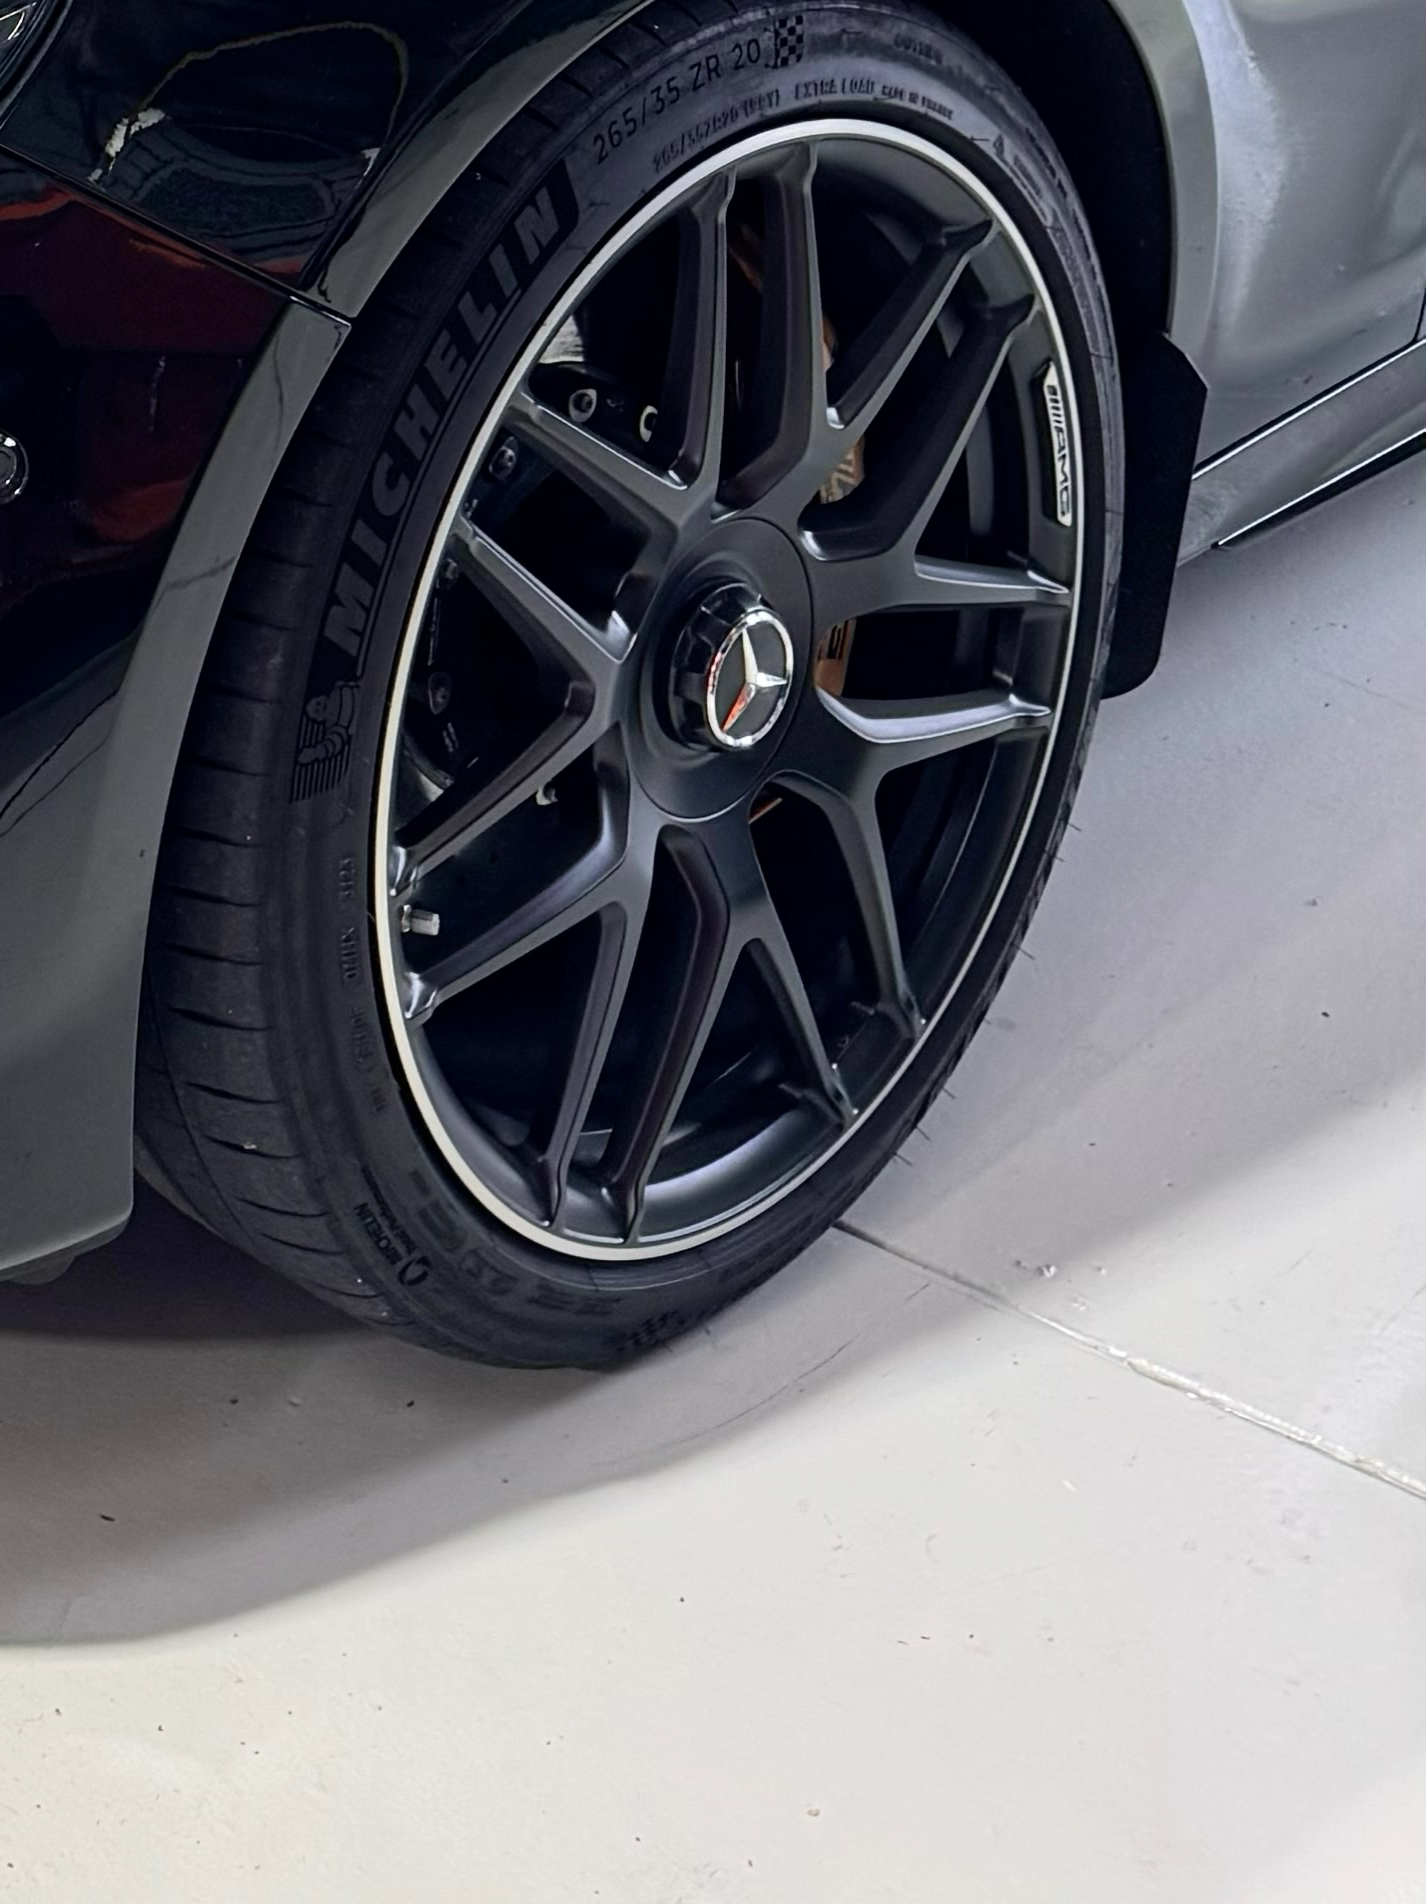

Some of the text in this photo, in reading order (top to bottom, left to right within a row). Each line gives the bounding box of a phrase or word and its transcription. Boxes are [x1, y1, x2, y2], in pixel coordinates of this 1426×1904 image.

[592, 37, 762, 165] 265/35 ZR 20
[323, 186, 564, 658] MICHELIN
[1054, 425, 1070, 518] AMG
